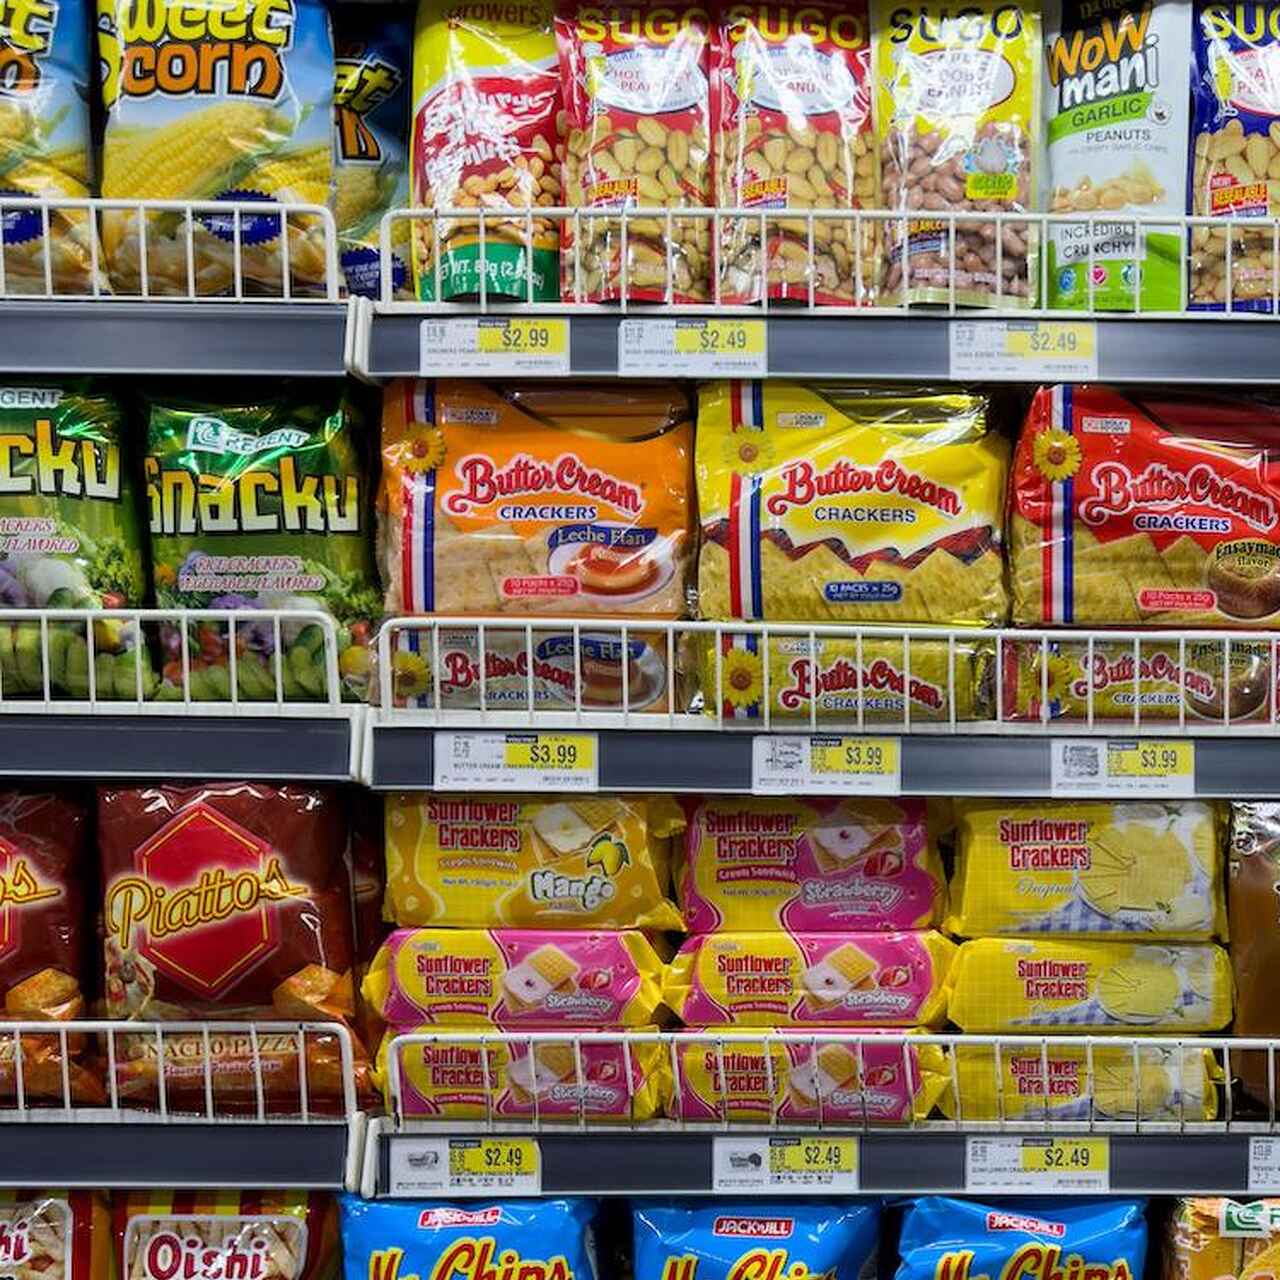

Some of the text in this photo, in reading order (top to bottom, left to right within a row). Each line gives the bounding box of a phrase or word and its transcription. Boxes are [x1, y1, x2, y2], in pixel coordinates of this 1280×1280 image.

[578, 5, 708, 45] SUGO
[730, 5, 866, 48] SUGO
[889, 4, 1023, 43] SUGO
[123, 43, 284, 98] corn
[1061, 33, 1160, 108] mani
[1072, 98, 1142, 127] GARLIC
[1086, 128, 1152, 144] PEANUTS
[502, 329, 549, 348] $2.99
[701, 328, 747, 348] $2.49
[1030, 331, 1077, 352] $2.49
[443, 454, 645, 514] Butter Cream
[767, 458, 963, 517] Butter Cream
[1080, 462, 1279, 532] Butter Cream
[500, 505, 598, 520] CRACKERS
[814, 507, 916, 523] CRACKERS
[1134, 515, 1230, 532] CRACKERS
[556, 526, 606, 546] Leche
[530, 742, 577, 764] $3.99
[846, 747, 883, 767] $3.99
[1141, 752, 1178, 771] $3.99
[427, 800, 519, 825] Sunflower
[705, 810, 799, 837] Sunflower
[438, 826, 520, 852] Crackers
[1000, 820, 1090, 846] Sunflower
[716, 836, 799, 862] Crackers
[1011, 845, 1091, 870] Crackers
[529, 870, 616, 910] Mango
[803, 878, 902, 909] Strawberry
[108, 858, 309, 949] Piattos
[416, 955, 491, 976] Sunflower
[1018, 959, 1088, 980] Sunflower
[425, 976, 493, 997] Crackers
[1024, 979, 1089, 1000] Crackers
[484, 1149, 522, 1169] $2.49
[805, 1147, 841, 1166] $2.49
[1044, 1149, 1091, 1168] $2.49
